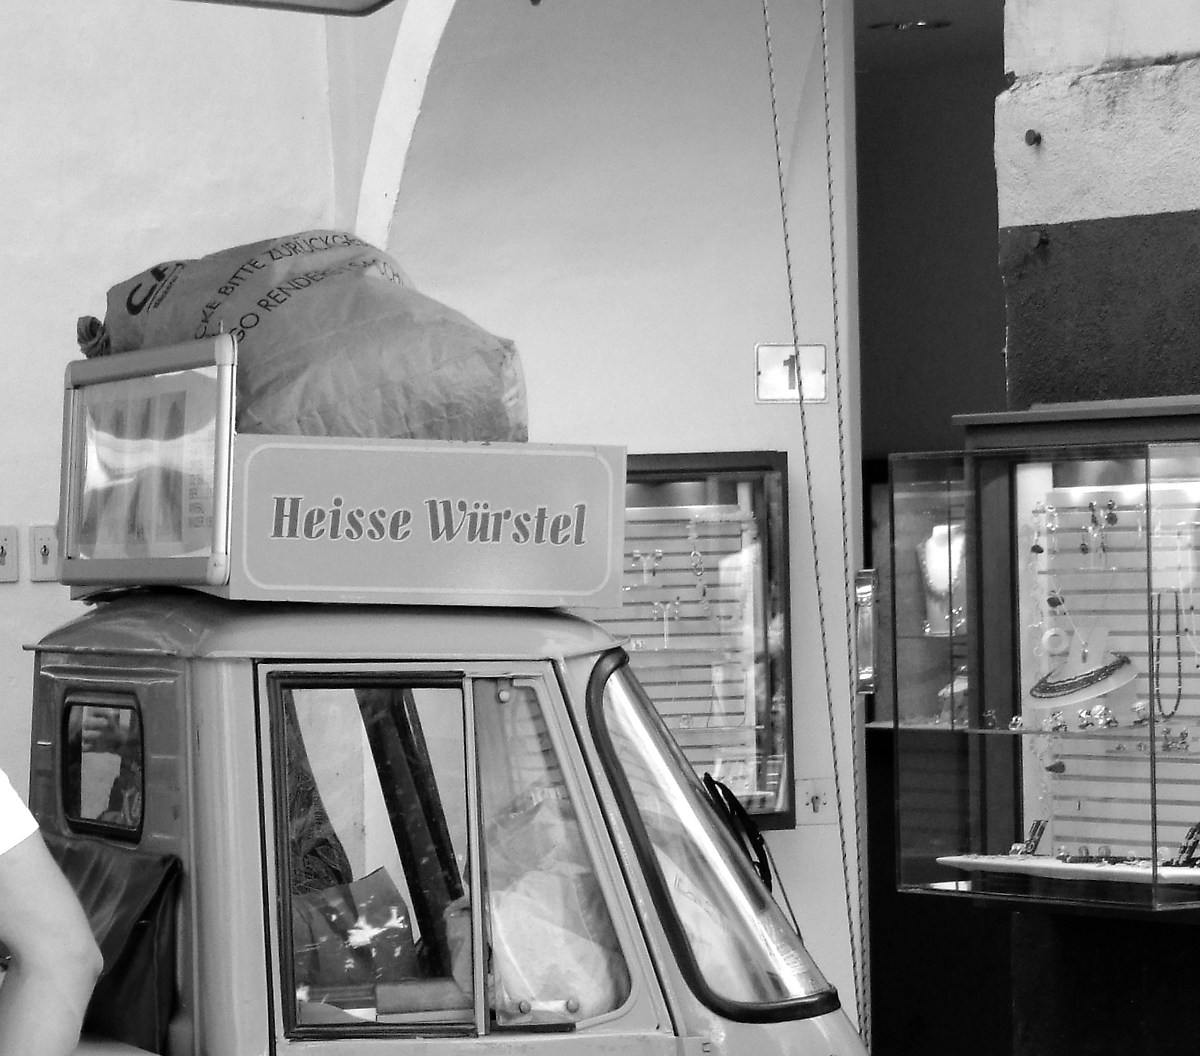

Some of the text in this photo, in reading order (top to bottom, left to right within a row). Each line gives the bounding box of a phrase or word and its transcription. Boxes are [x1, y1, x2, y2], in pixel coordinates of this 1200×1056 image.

[218, 257, 266, 296] BITTE
[782, 354, 799, 391] 1
[270, 496, 412, 543] Heisse
[425, 499, 587, 546] Würstel
